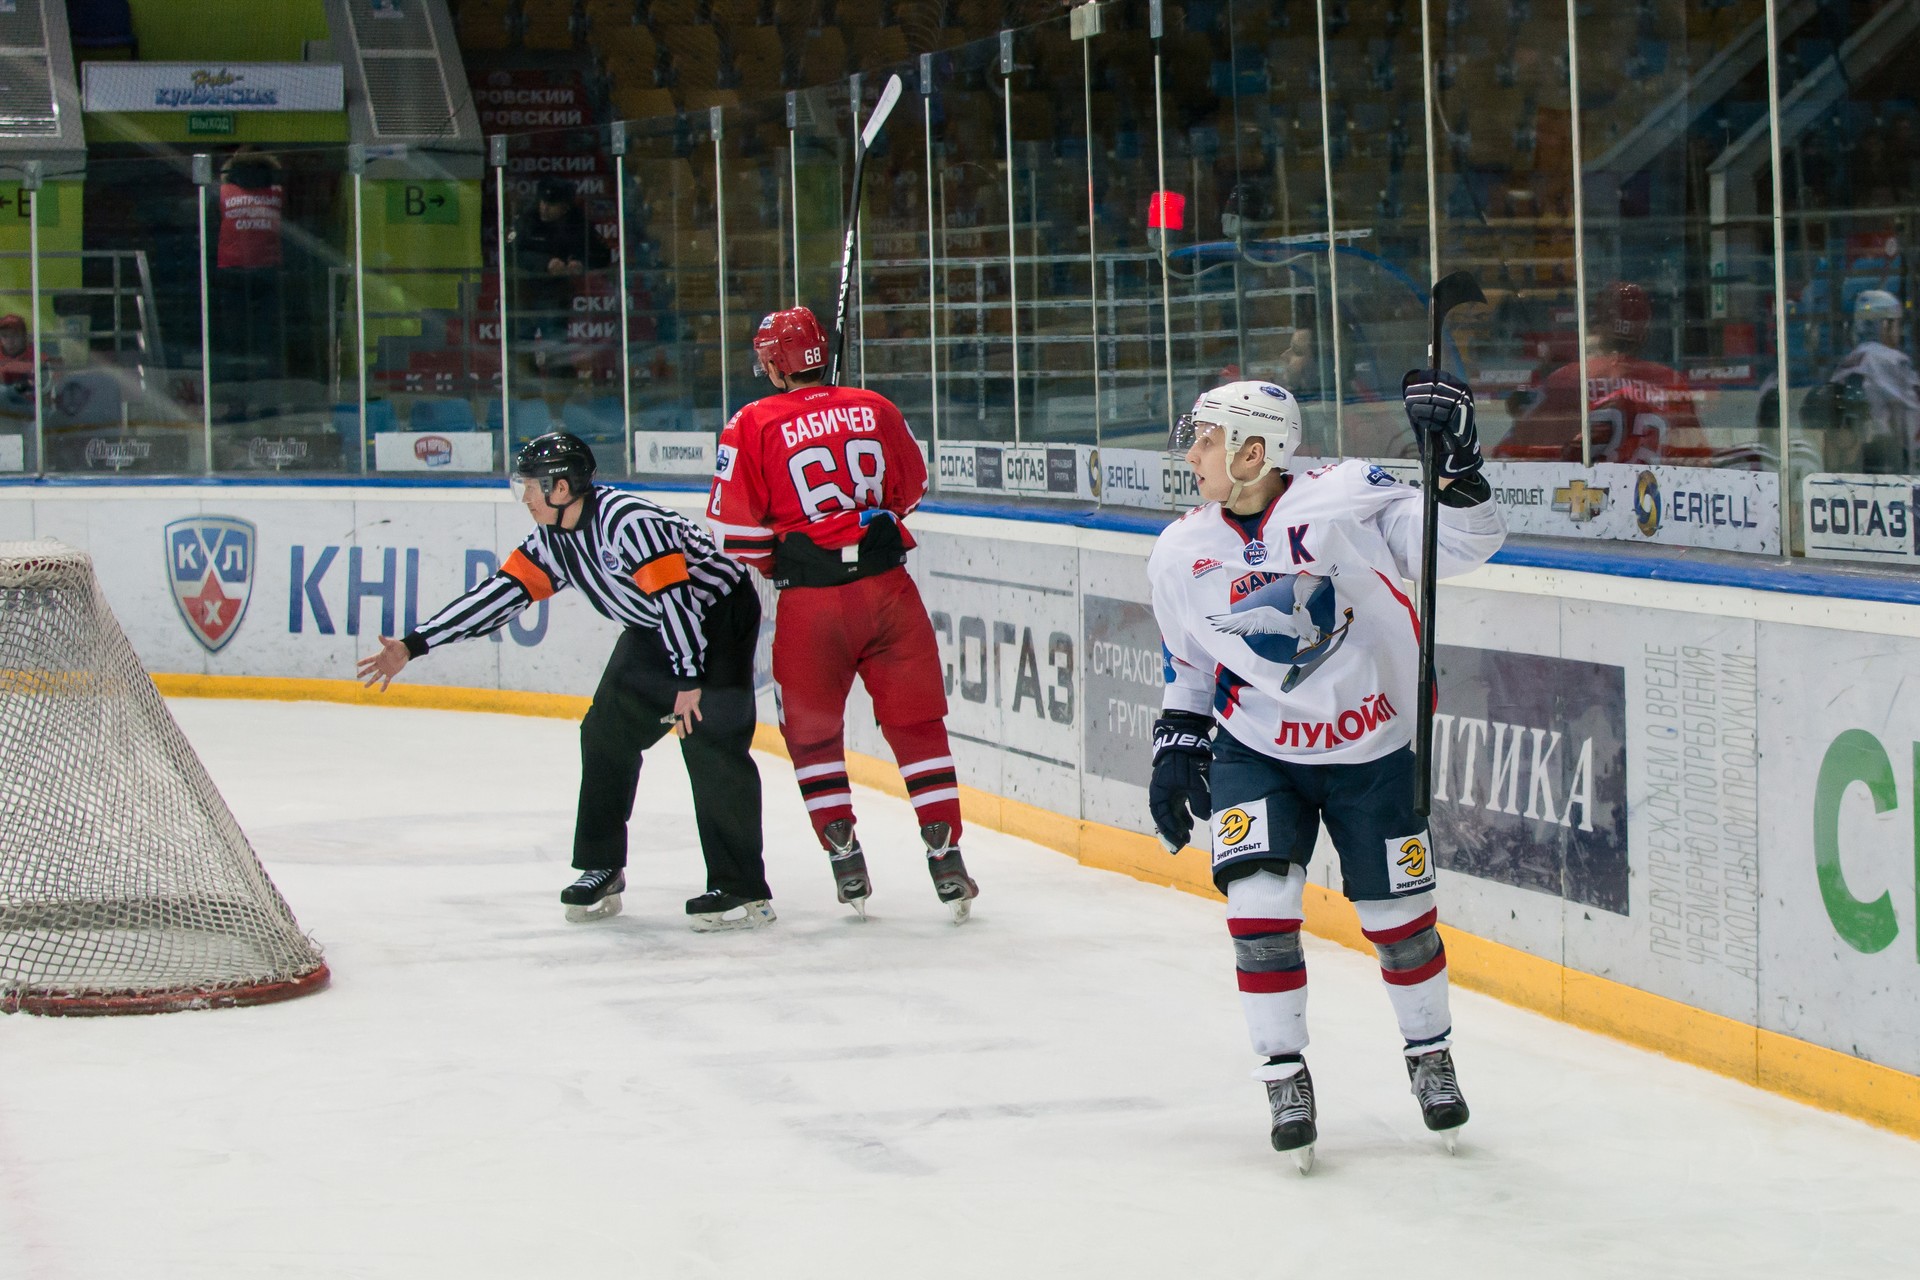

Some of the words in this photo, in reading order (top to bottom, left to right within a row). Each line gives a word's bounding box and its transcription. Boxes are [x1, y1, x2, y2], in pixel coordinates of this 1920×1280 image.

[191, 117, 229, 132] ВЫХОД
[804, 346, 822, 366] 68
[780, 406, 876, 449] БАБИЧЕВ
[788, 438, 887, 523] 68
[940, 455, 974, 478] СОГАЗ
[1006, 457, 1045, 482] СОГАЗ
[1108, 465, 1150, 491] ERIELL
[1162, 468, 1200, 496] СОГА
[1491, 487, 1545, 506] EVROLET
[1673, 490, 1758, 529] ERIELL
[1809, 497, 1907, 538] СОГАЗ
[930, 610, 1075, 726] СОГАЗ
[1093, 640, 1165, 689] СТРАХОВ
[1644, 642, 1679, 719] ВРЕДЕ
[1107, 698, 1161, 742] ГРУПП
[1274, 692, 1398, 749] ЛУКОЙЛ
[1645, 723, 1679, 741] О
[1681, 644, 1718, 807] ПОТРЕБЛЕНИЯ
[1721, 652, 1758, 802] ПРОДУКЦИИ
[1431, 713, 1594, 832] ЛТИКА
[1216, 841, 1262, 861] ЭНЕРГОСБЫТ
[1645, 746, 1681, 961] ПРЕДУПРЕЖДАЕМ
[1683, 809, 1720, 966] ЧРЕЗМЕРНОГО
